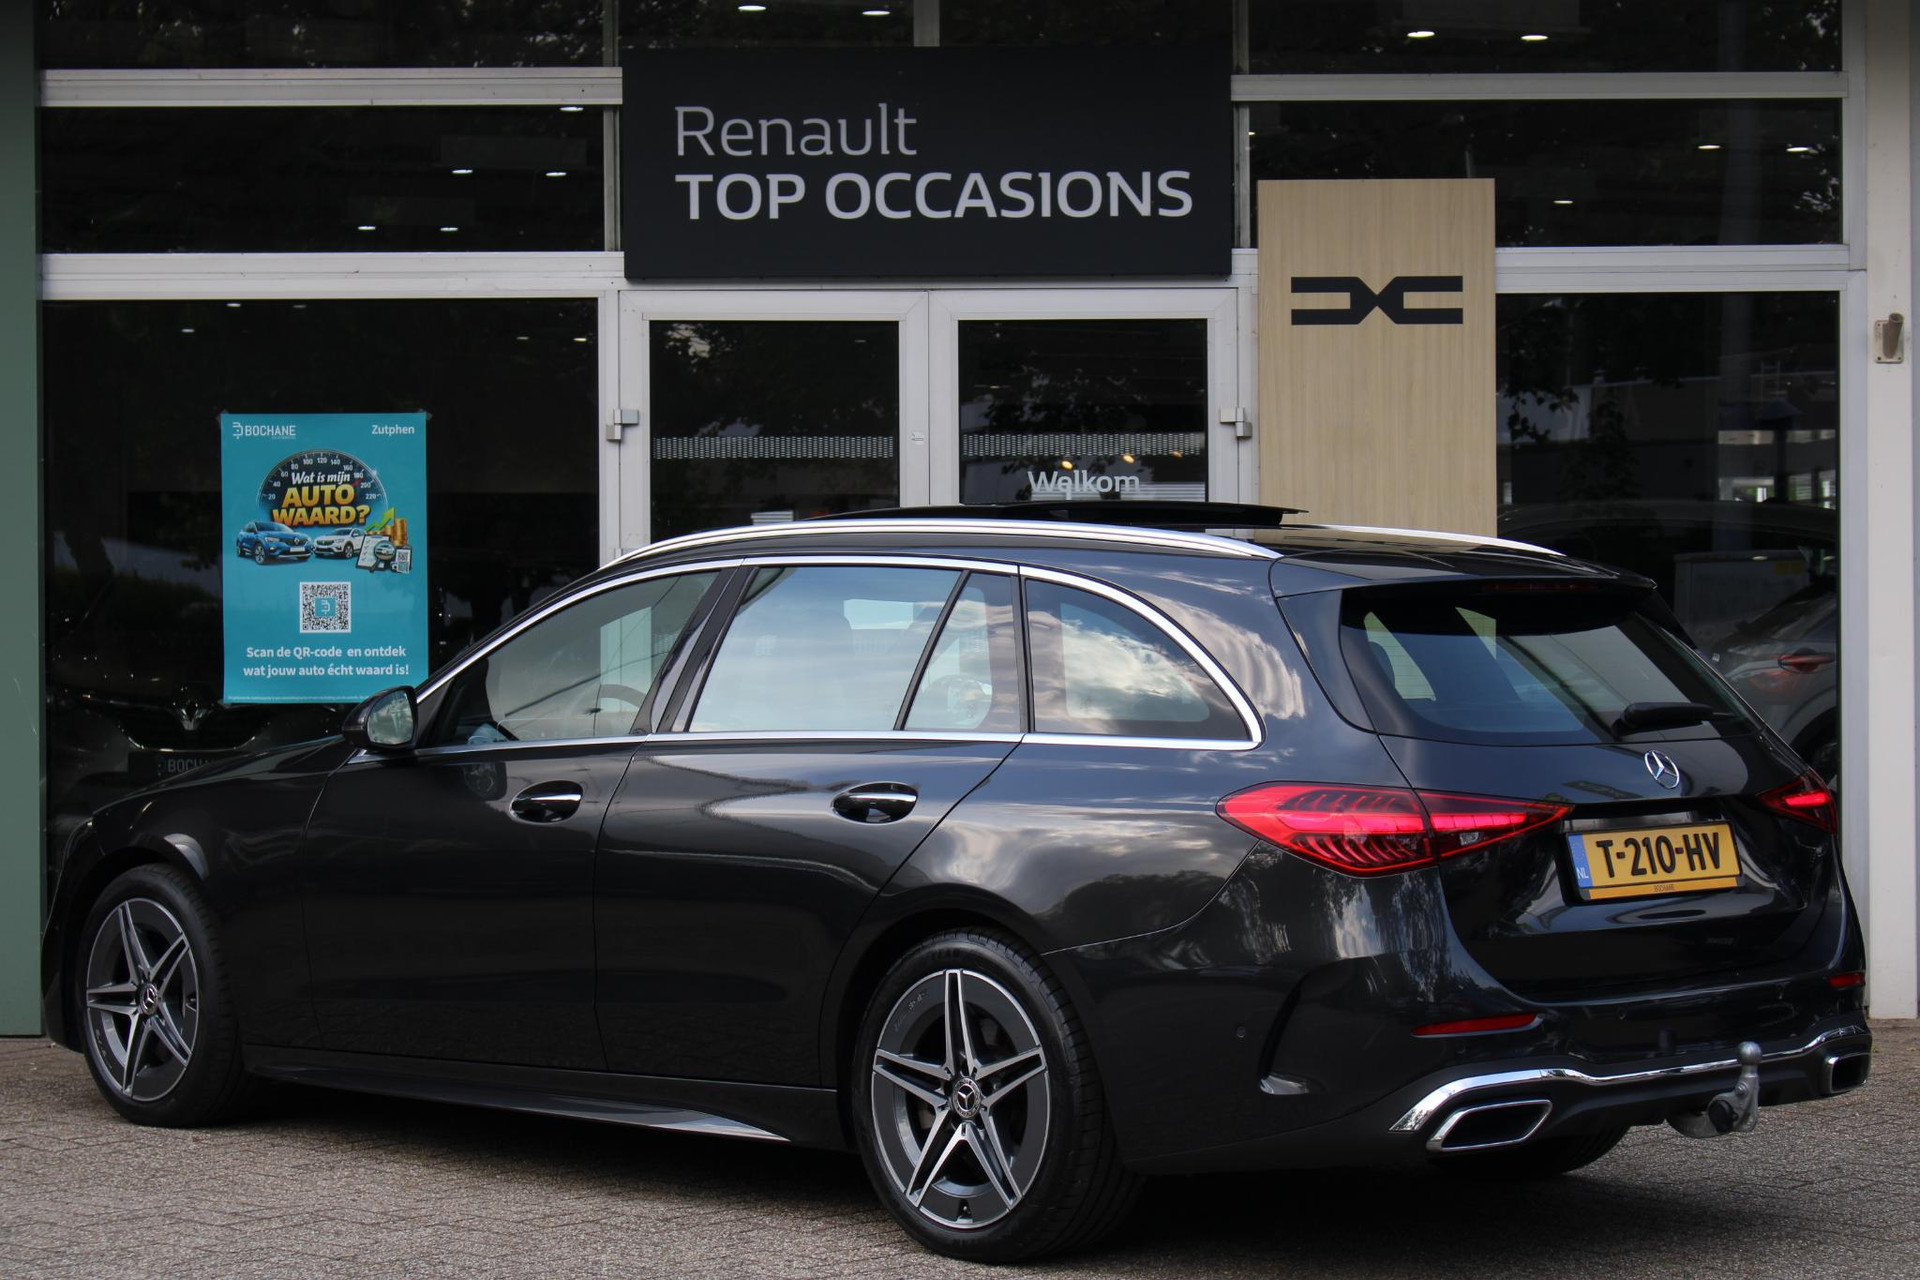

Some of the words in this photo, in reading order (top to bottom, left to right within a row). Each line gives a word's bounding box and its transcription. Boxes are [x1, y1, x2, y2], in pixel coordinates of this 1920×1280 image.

[675, 103, 917, 156] Renault
[675, 173, 806, 220] TOP
[825, 170, 1193, 219] OCCASIONS
[245, 425, 297, 437] BOCHANE
[371, 424, 415, 437] Zutphen
[291, 471, 316, 485] Wat
[317, 471, 325, 483] is
[326, 471, 350, 485] mijn
[1027, 470, 1140, 493] Welkom
[281, 484, 355, 508] AUTO
[272, 504, 370, 527] WAARD?
[246, 647, 275, 658] Scan
[276, 646, 291, 657] de
[293, 646, 342, 660] QR-code
[347, 648, 362, 657] en
[364, 646, 406, 657] ontdek
[243, 666, 265, 676] wat
[266, 665, 296, 679] jouw
[299, 665, 325, 676] auto
[327, 664, 353, 676] écht
[356, 664, 392, 676] waard
[395, 664, 409, 675] is!
[1596, 832, 1719, 878] T-210-HV
[1576, 867, 1589, 879] NL
